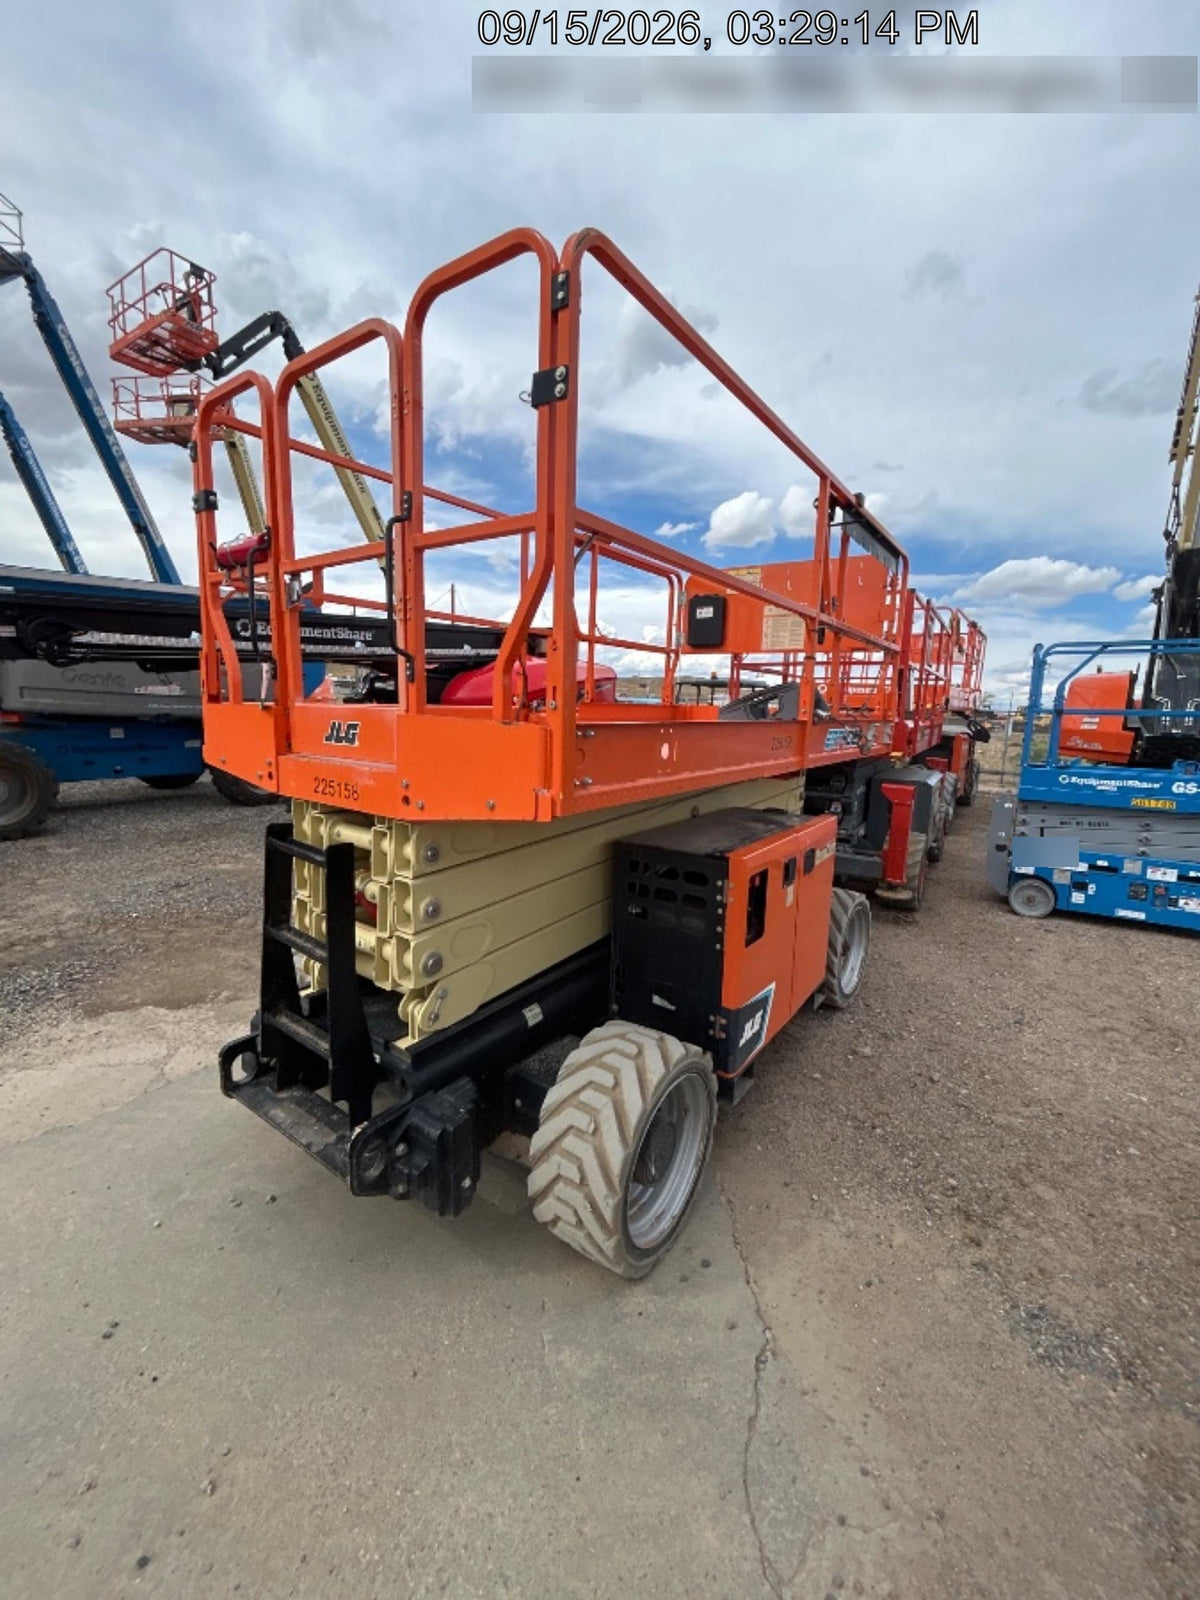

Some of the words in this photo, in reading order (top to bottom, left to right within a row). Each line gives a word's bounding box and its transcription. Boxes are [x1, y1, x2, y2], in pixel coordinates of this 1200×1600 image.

[312, 384, 366, 493] Equipmentare
[61, 668, 126, 688] Genie
[324, 720, 361, 746] JLG
[738, 1008, 764, 1048] JLG
